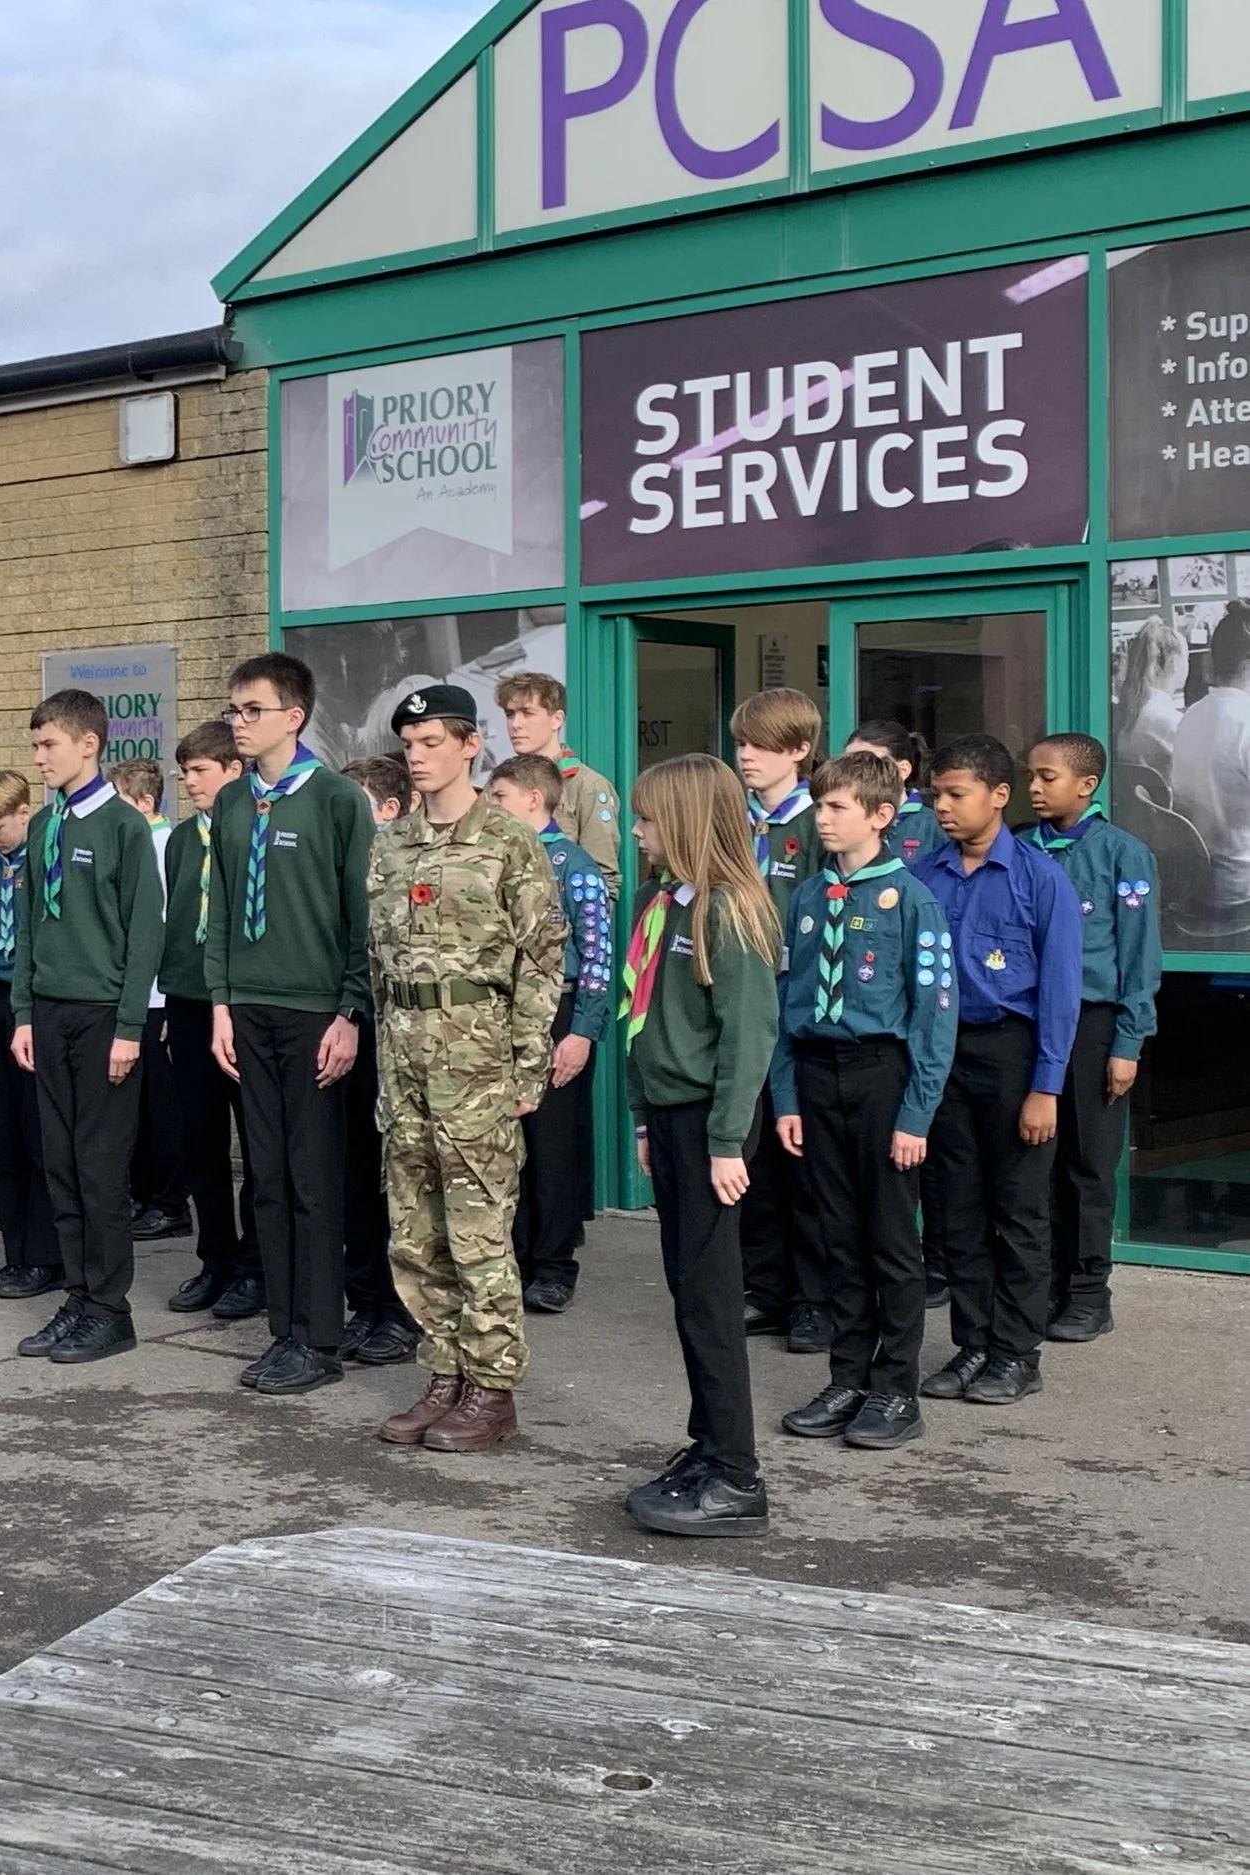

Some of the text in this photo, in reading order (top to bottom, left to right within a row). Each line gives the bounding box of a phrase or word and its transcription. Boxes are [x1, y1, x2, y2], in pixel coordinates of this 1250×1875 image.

[541, 0, 1122, 211] PCSA
[1186, 311, 1248, 342] Sup
[1187, 352, 1248, 384] Info
[382, 381, 496, 426] PRIORY
[634, 332, 1023, 456] STUDENT
[368, 408, 498, 461] Community
[382, 441, 498, 484] SCHOOL
[628, 418, 1029, 534] SERVICES
[416, 479, 497, 502] An Academy
[70, 663, 128, 679] Welcome
